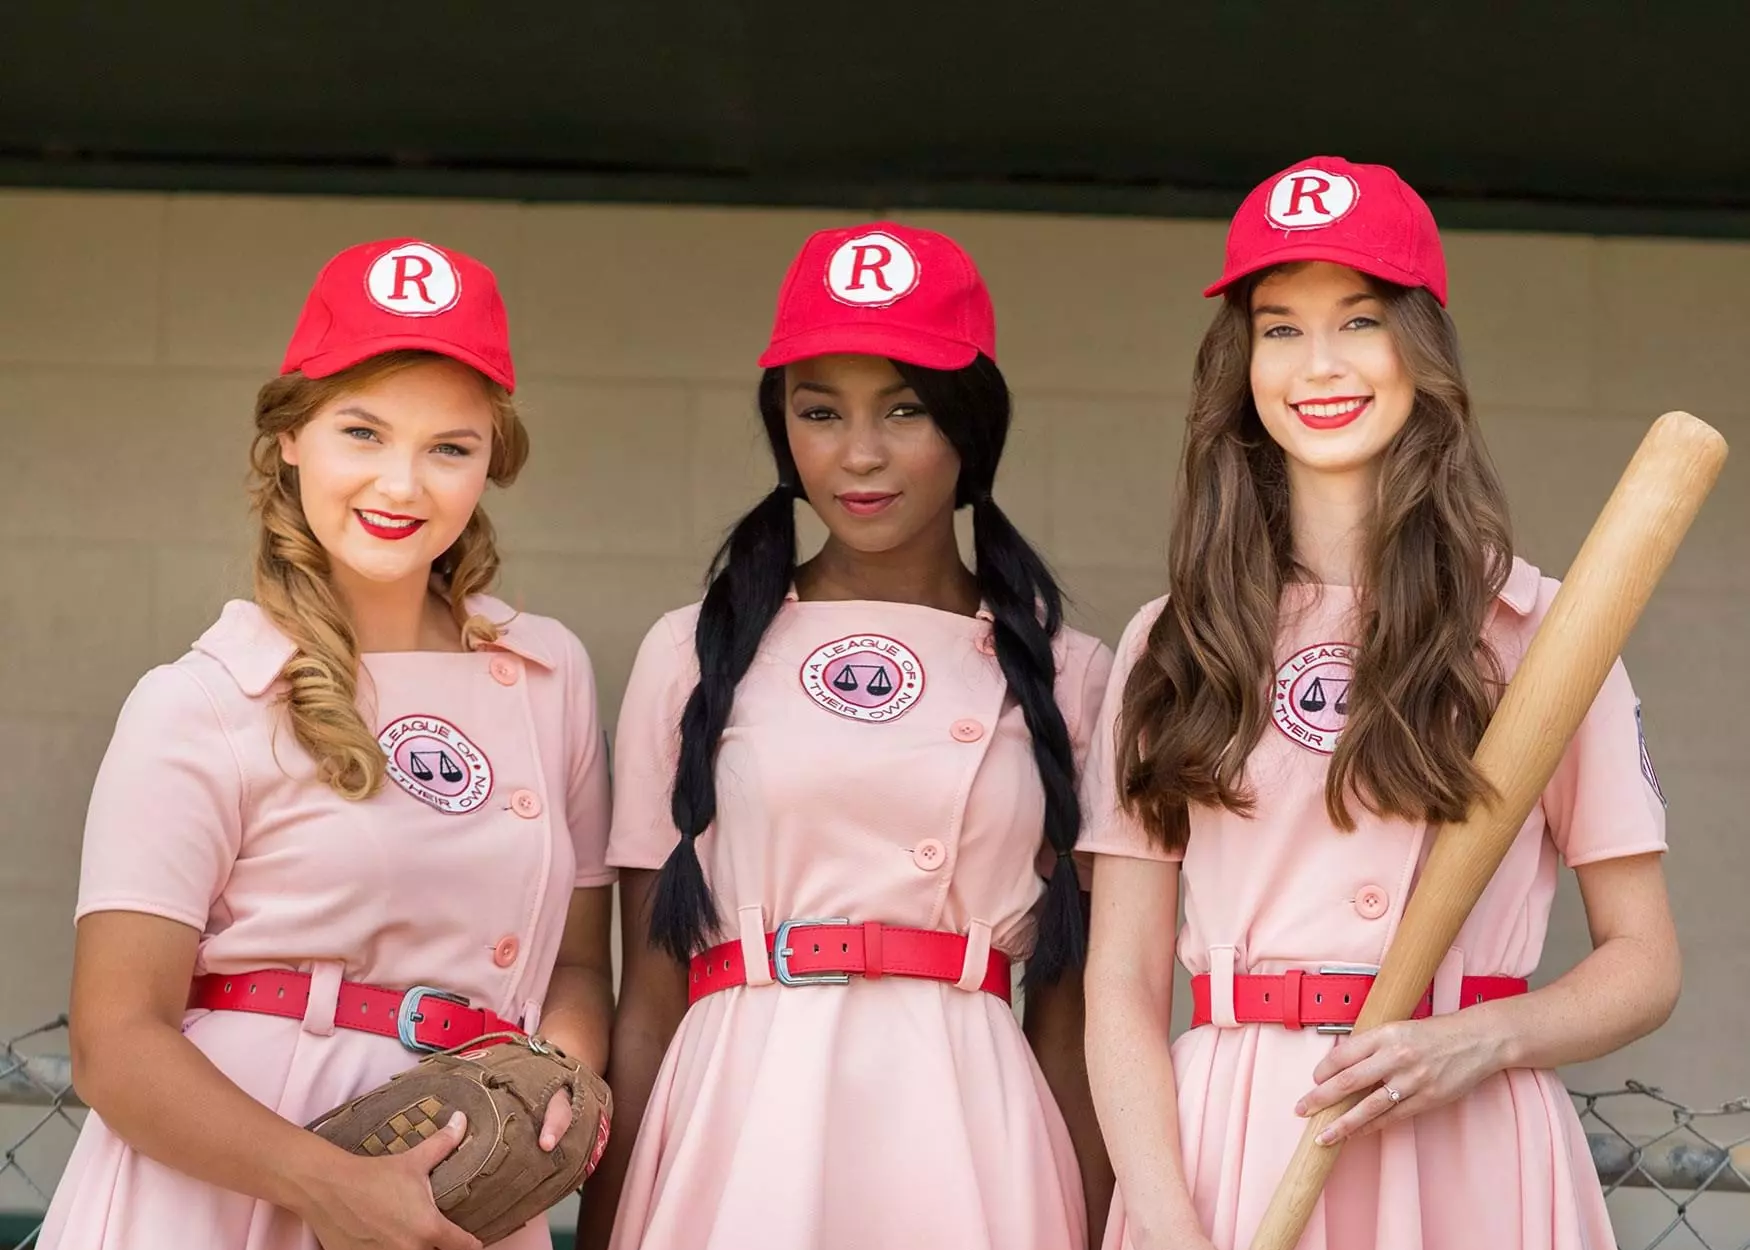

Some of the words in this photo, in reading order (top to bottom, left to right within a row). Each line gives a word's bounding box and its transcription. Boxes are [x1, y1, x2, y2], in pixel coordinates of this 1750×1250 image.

[1283, 176, 1331, 216] R
[387, 255, 436, 304] R
[844, 244, 893, 291] R
[810, 663, 822, 672] A
[822, 639, 900, 658] LEAGUE
[902, 660, 916, 680] OF
[810, 683, 858, 715] THEIR
[869, 692, 912, 719] OWN
[1278, 678, 1290, 689] A
[382, 720, 451, 749] LEAGUE
[457, 742, 478, 762] OF
[1276, 704, 1323, 746] THEIR
[399, 774, 452, 808] THEIR
[459, 775, 487, 807] OWN
